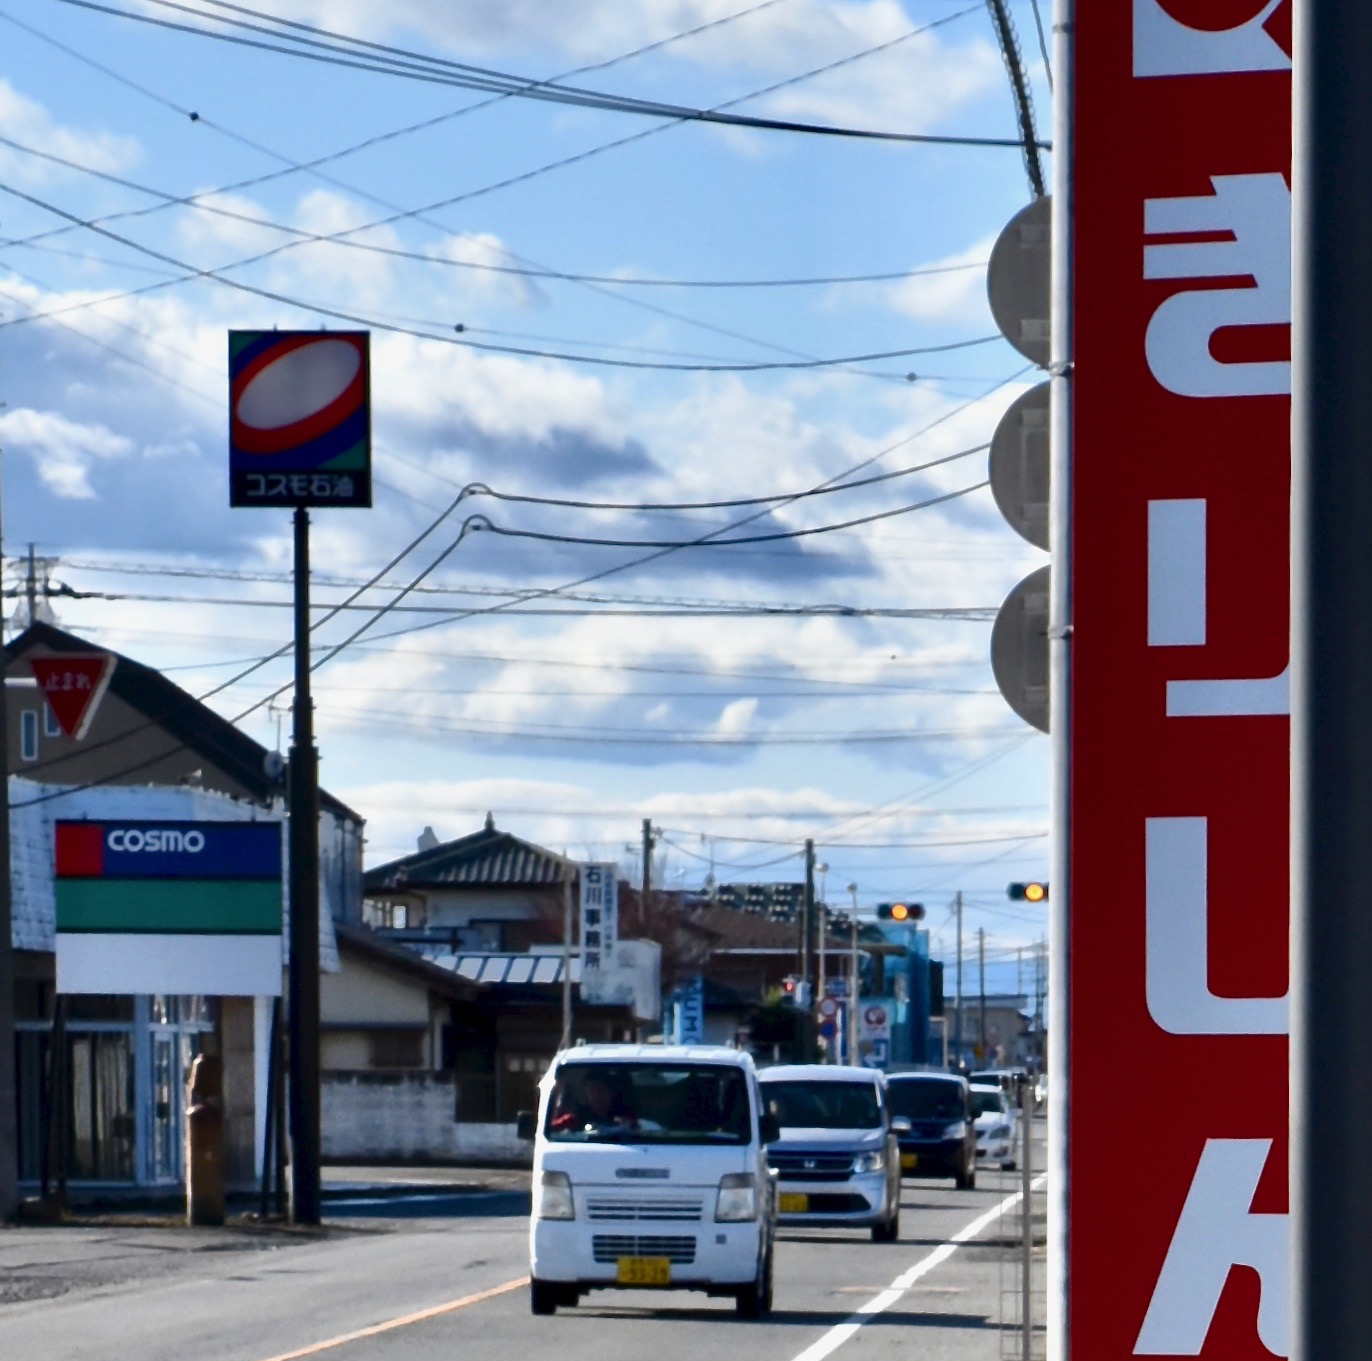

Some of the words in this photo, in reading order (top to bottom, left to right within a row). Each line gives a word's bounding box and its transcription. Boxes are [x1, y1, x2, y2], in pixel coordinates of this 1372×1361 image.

[246, 473, 355, 497] コスモ石油
[107, 829, 205, 853] COSMO
